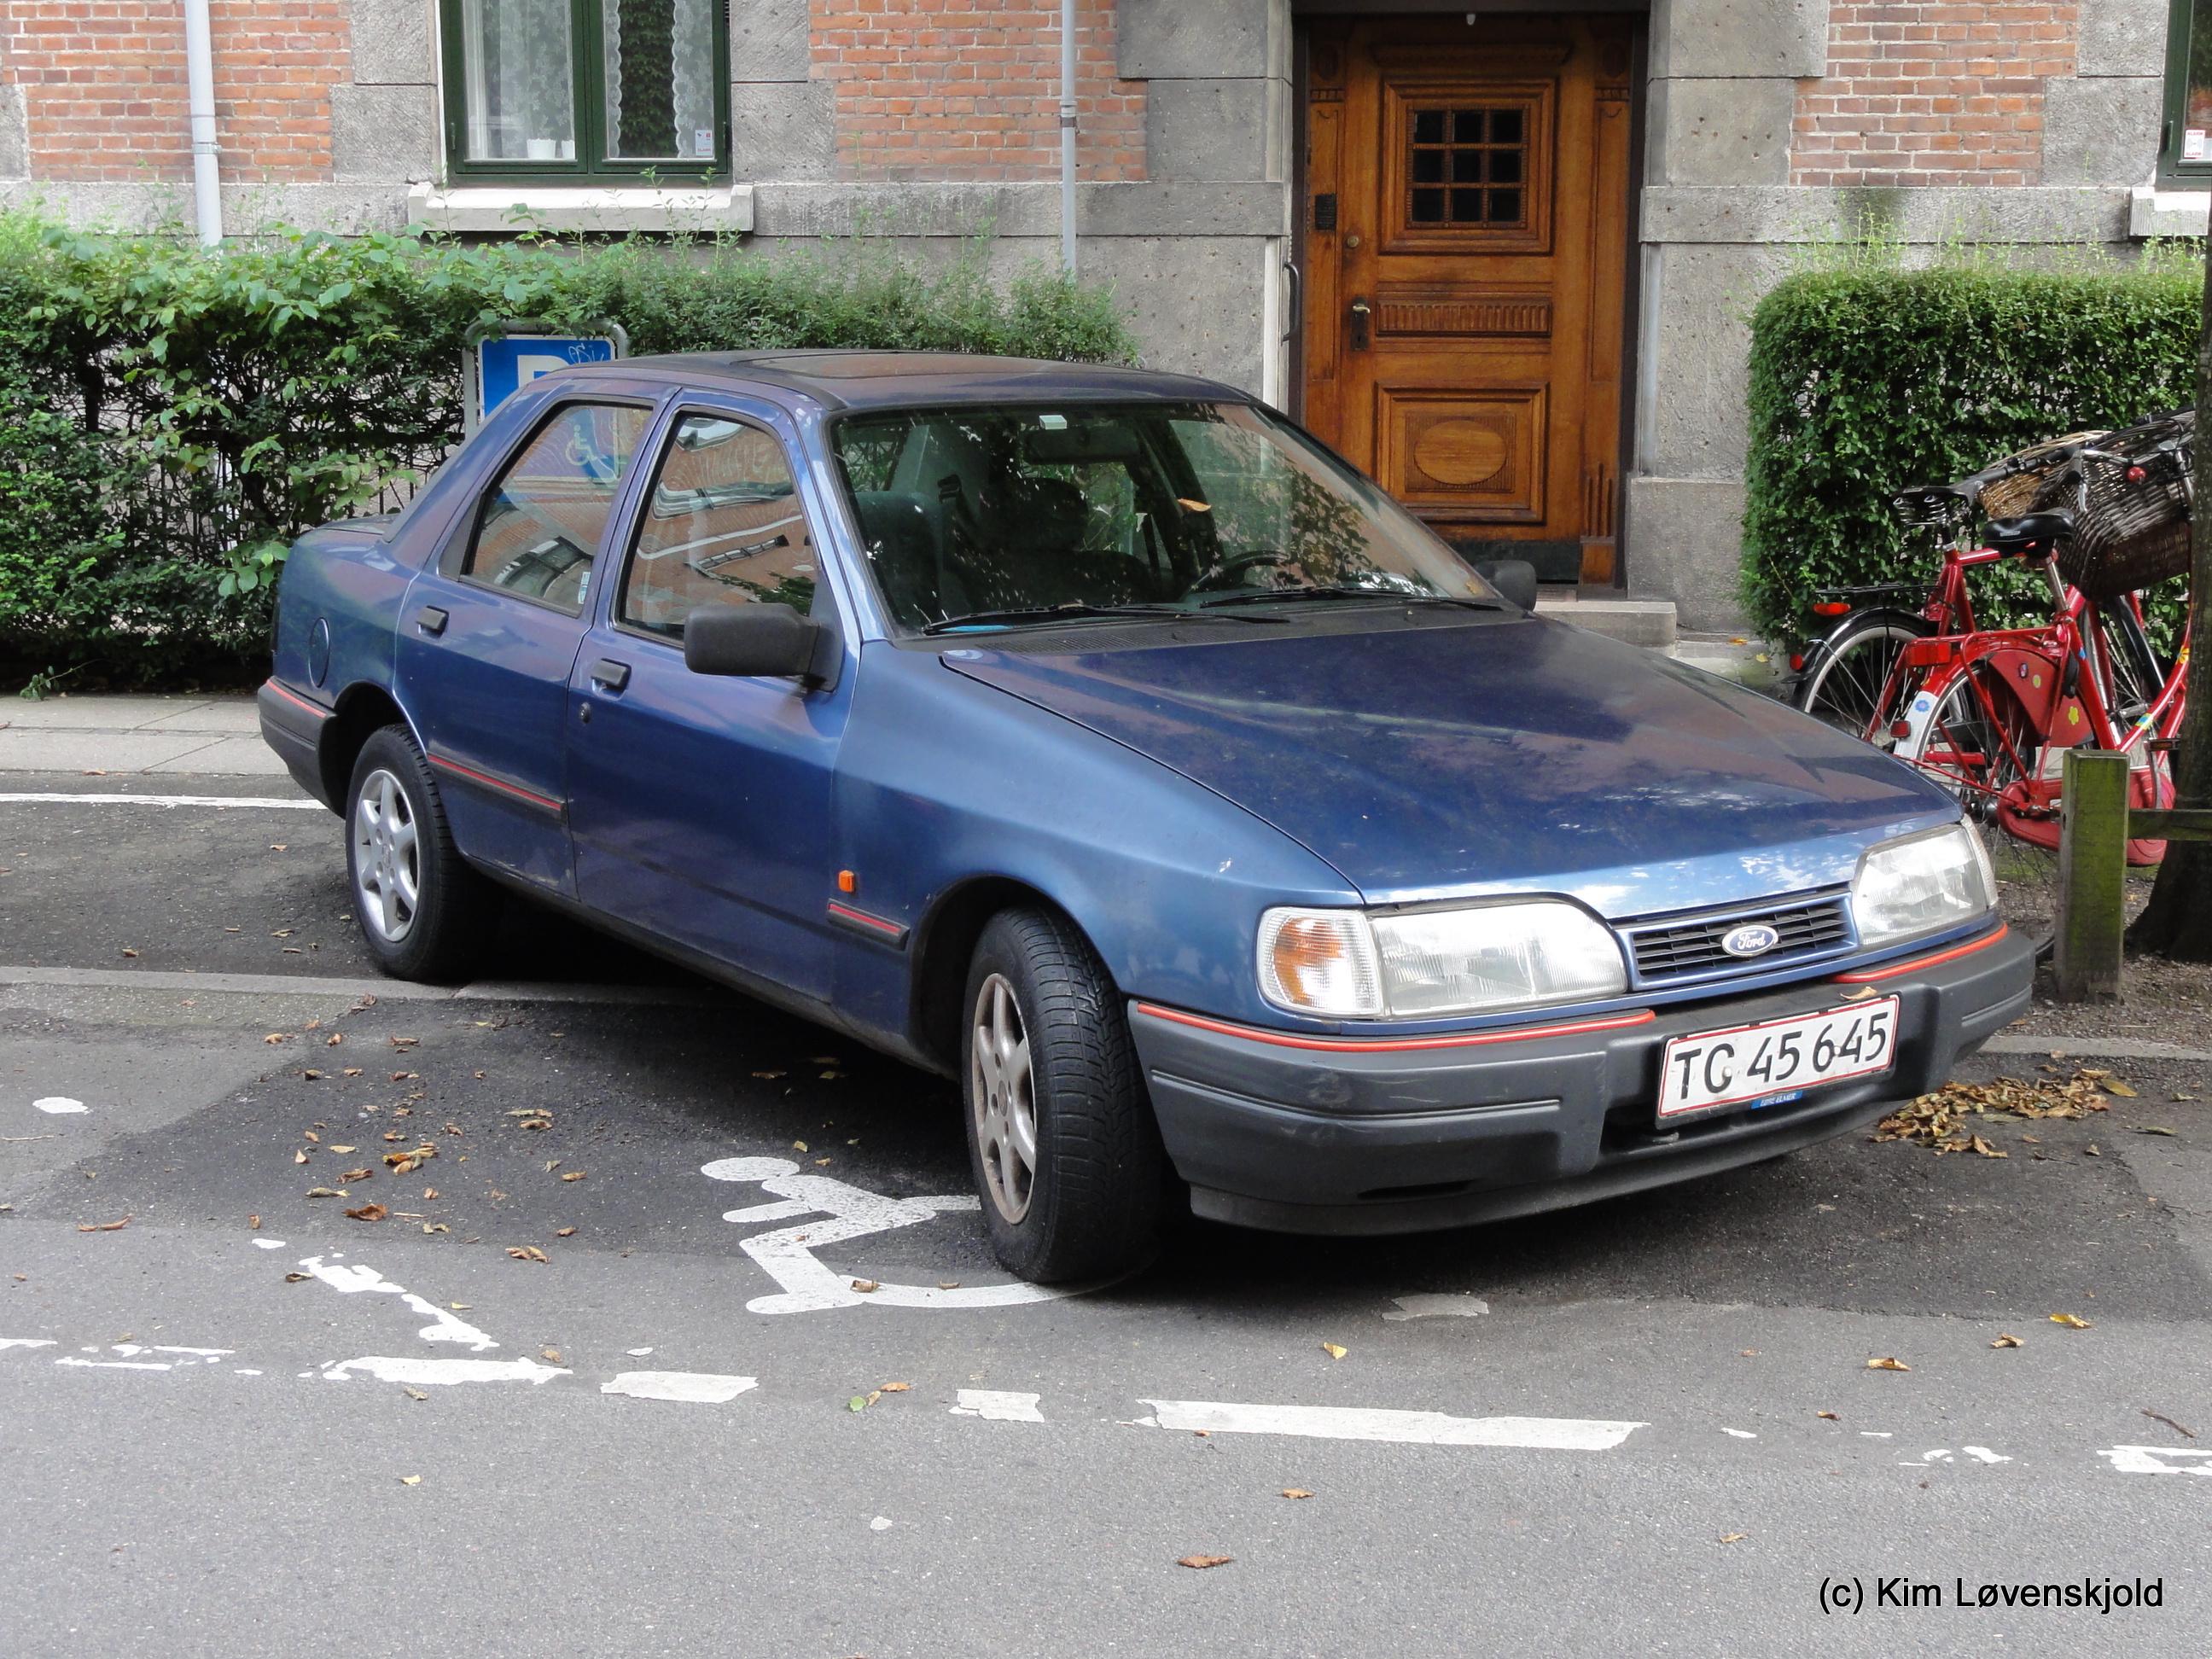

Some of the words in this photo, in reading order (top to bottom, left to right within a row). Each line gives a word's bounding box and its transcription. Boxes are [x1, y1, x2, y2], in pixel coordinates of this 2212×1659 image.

[1737, 930, 1767, 950] Ford
[1674, 1043, 1735, 1100] TC
[1746, 1030, 1802, 1083] 45
[1812, 1011, 1889, 1073] 645
